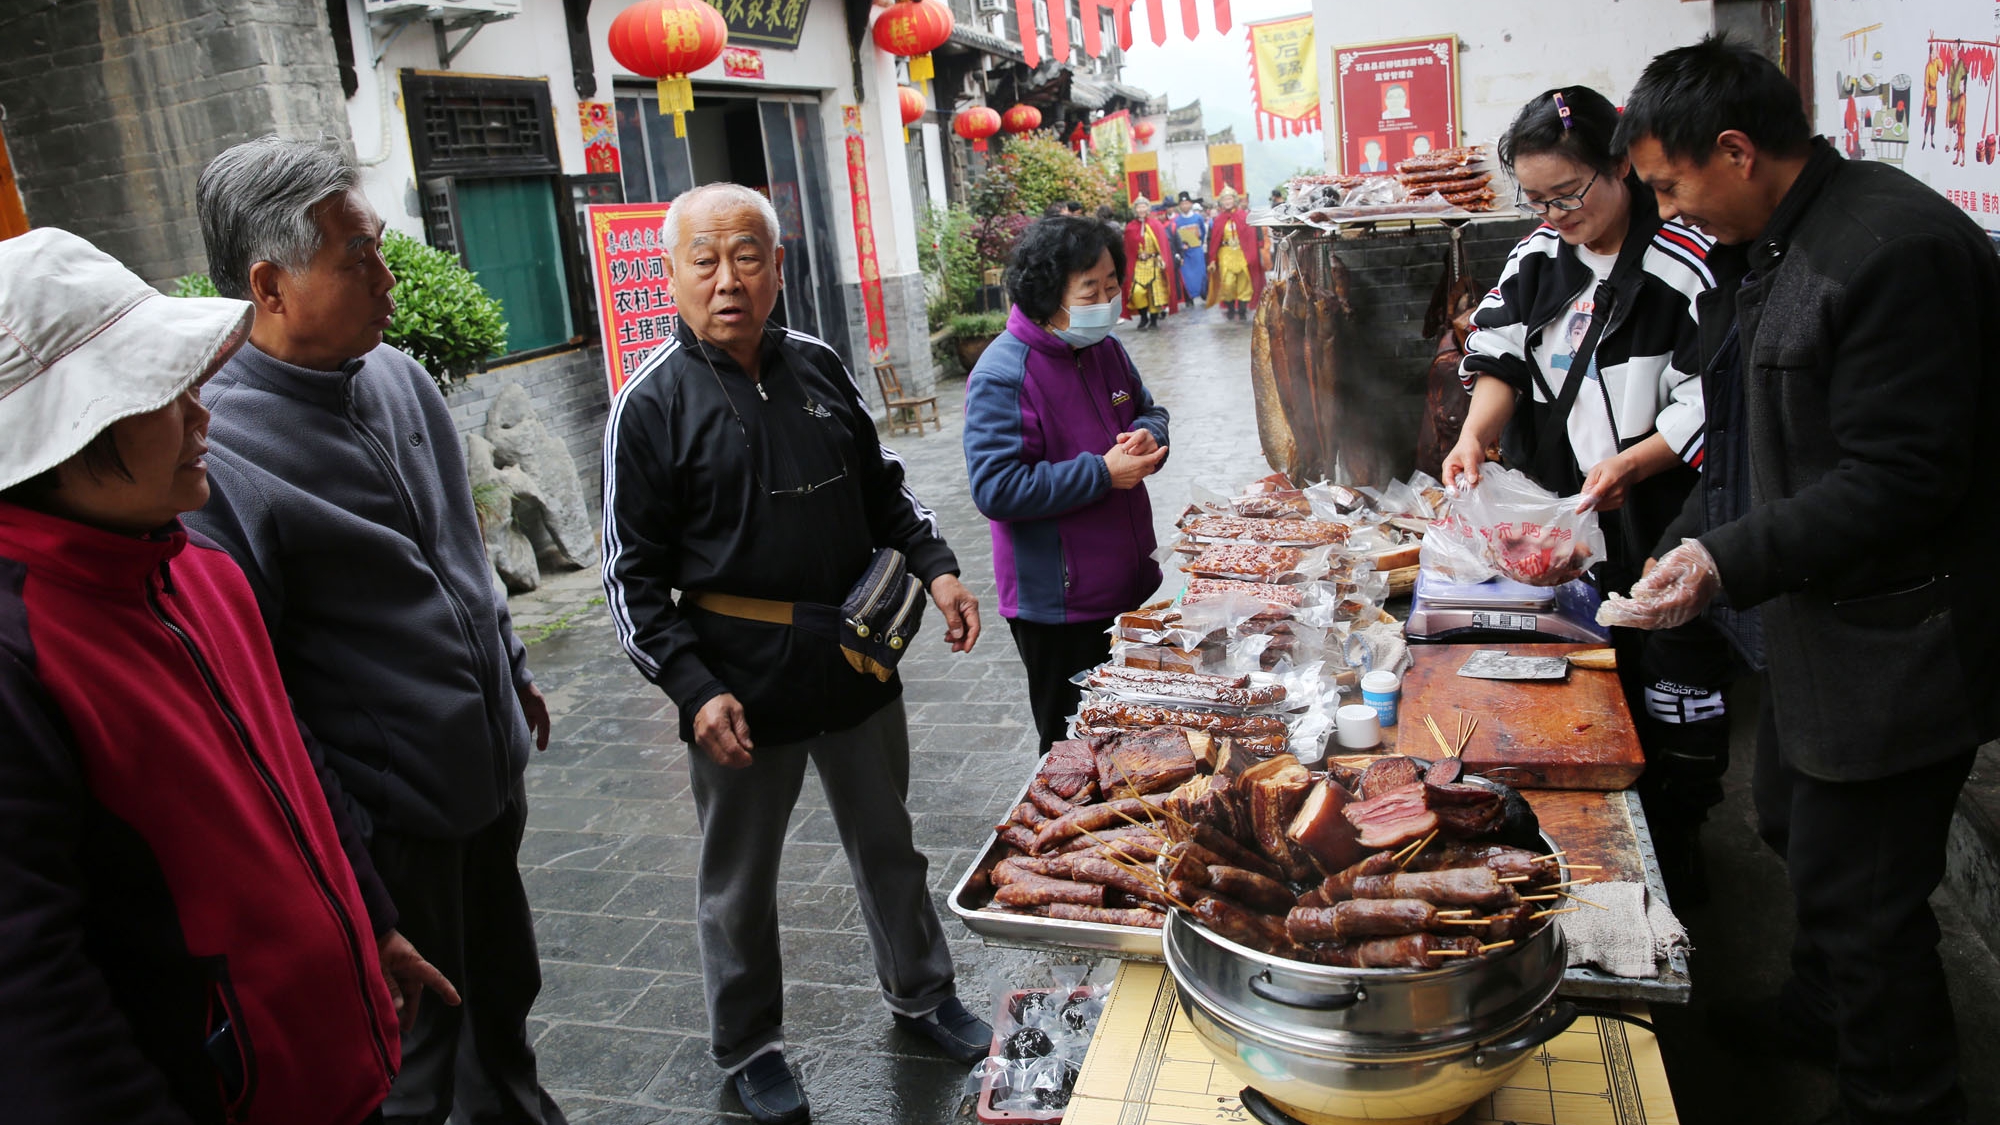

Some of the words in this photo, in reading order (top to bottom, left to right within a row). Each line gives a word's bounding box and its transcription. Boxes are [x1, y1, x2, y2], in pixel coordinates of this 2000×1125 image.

[610, 258, 668, 284] 炒小河
[614, 287, 677, 313] 农村土
[622, 346, 658, 375] 红烧
